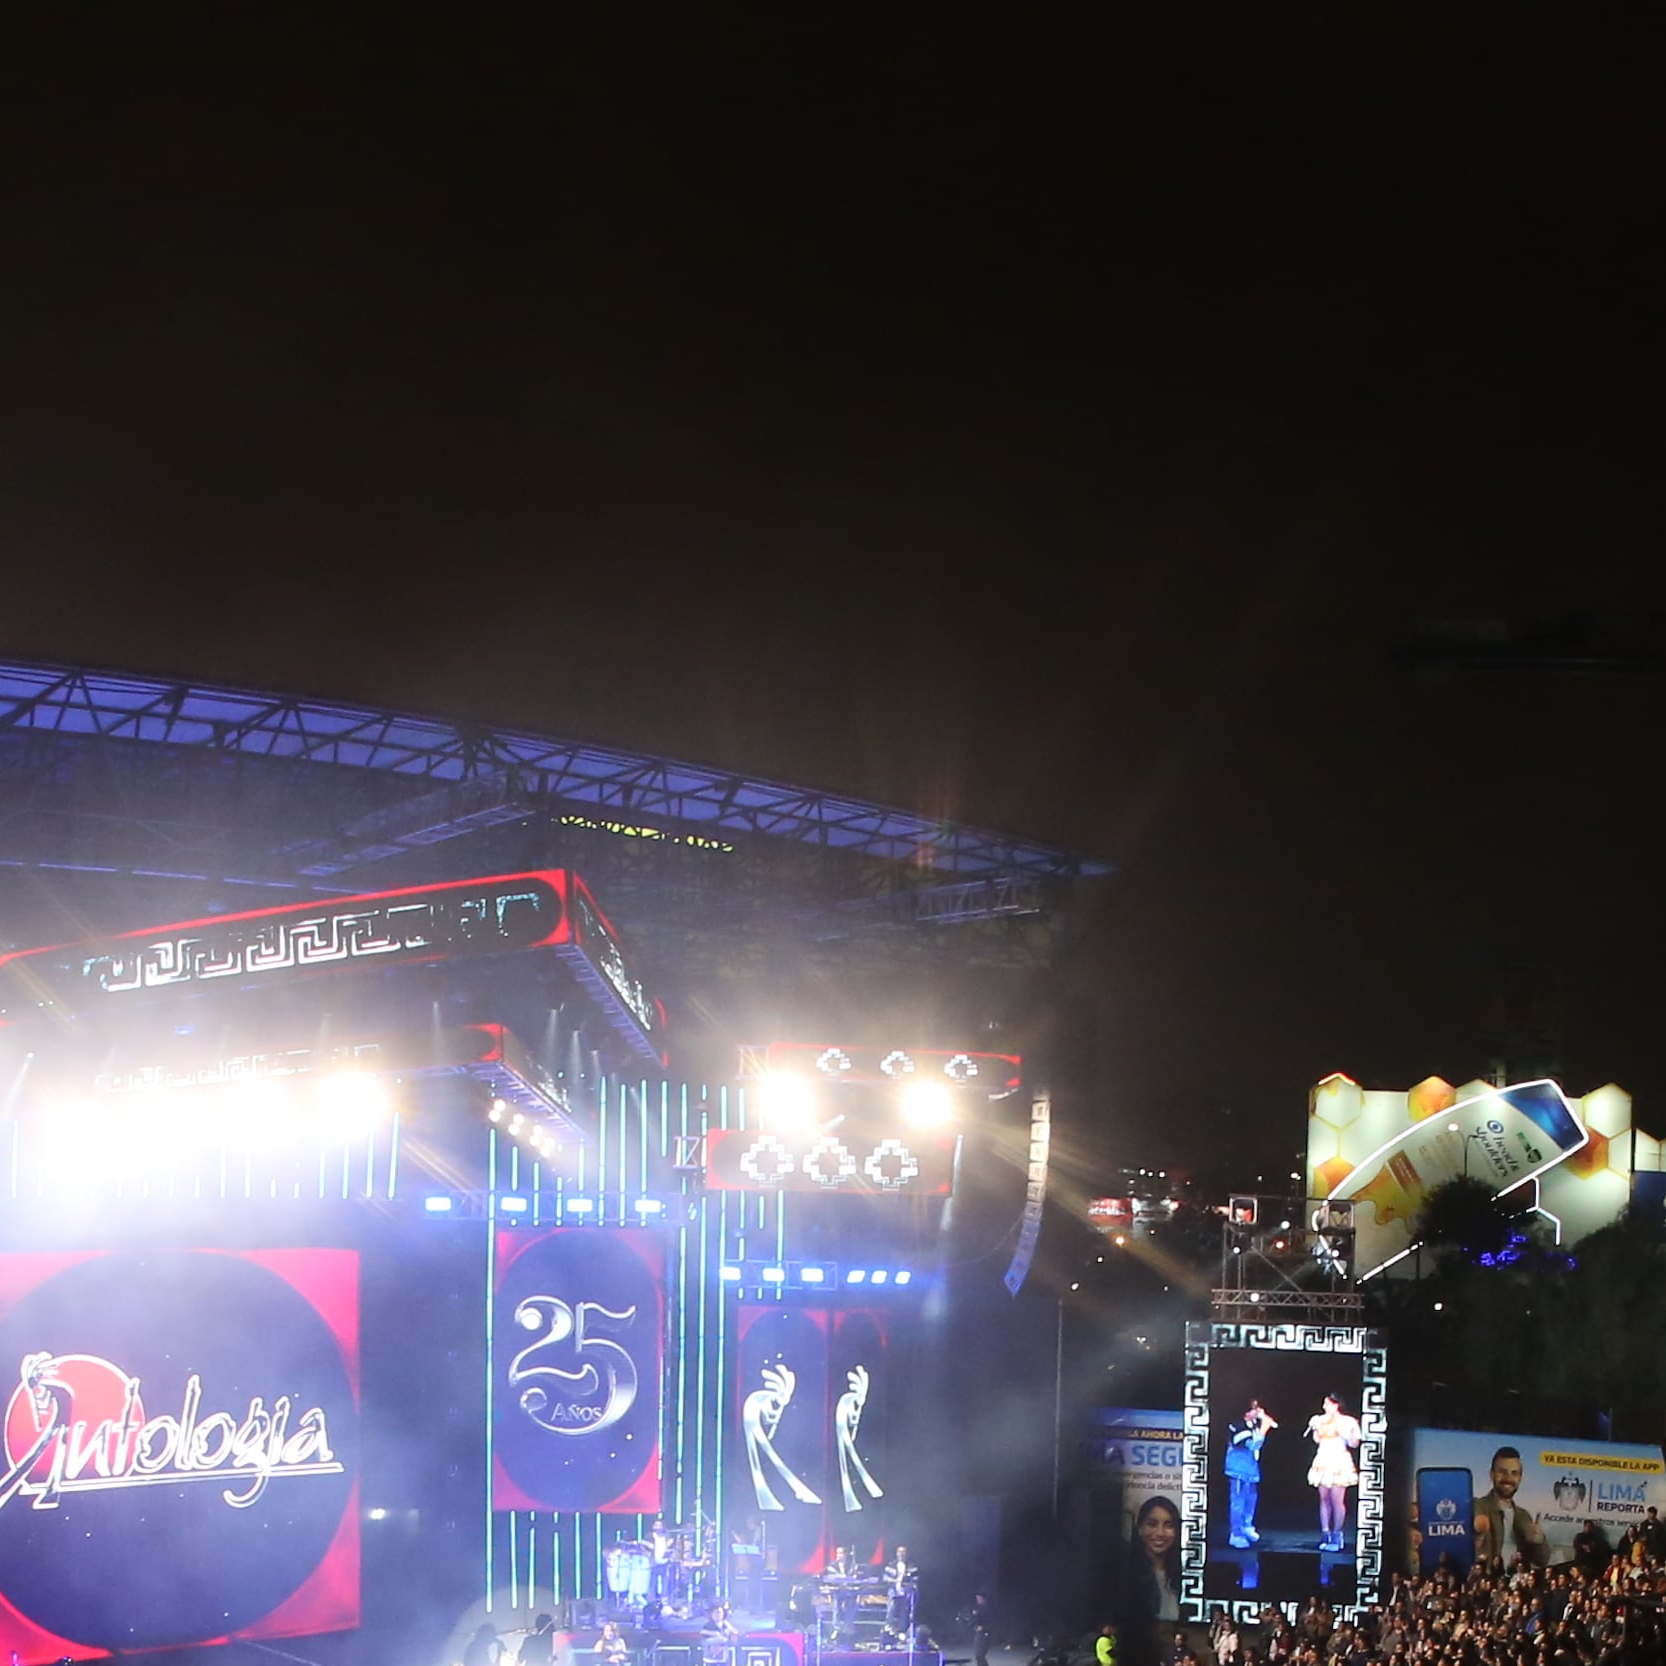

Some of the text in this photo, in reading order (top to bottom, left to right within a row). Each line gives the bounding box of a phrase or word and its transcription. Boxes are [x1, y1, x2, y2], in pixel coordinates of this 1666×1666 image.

[508, 1294, 639, 1435] 25
[551, 1401, 603, 1421] AÑOS
[1543, 1455, 1555, 1463] YA
[1579, 1458, 1628, 1469] DISPONIBLE
[1630, 1462, 1641, 1470] LA
[1642, 1463, 1660, 1472] APP
[1596, 1502, 1645, 1514] REPORTA
[1543, 1513, 1574, 1523] Accede
[1428, 1525, 1465, 1536] LIMA
